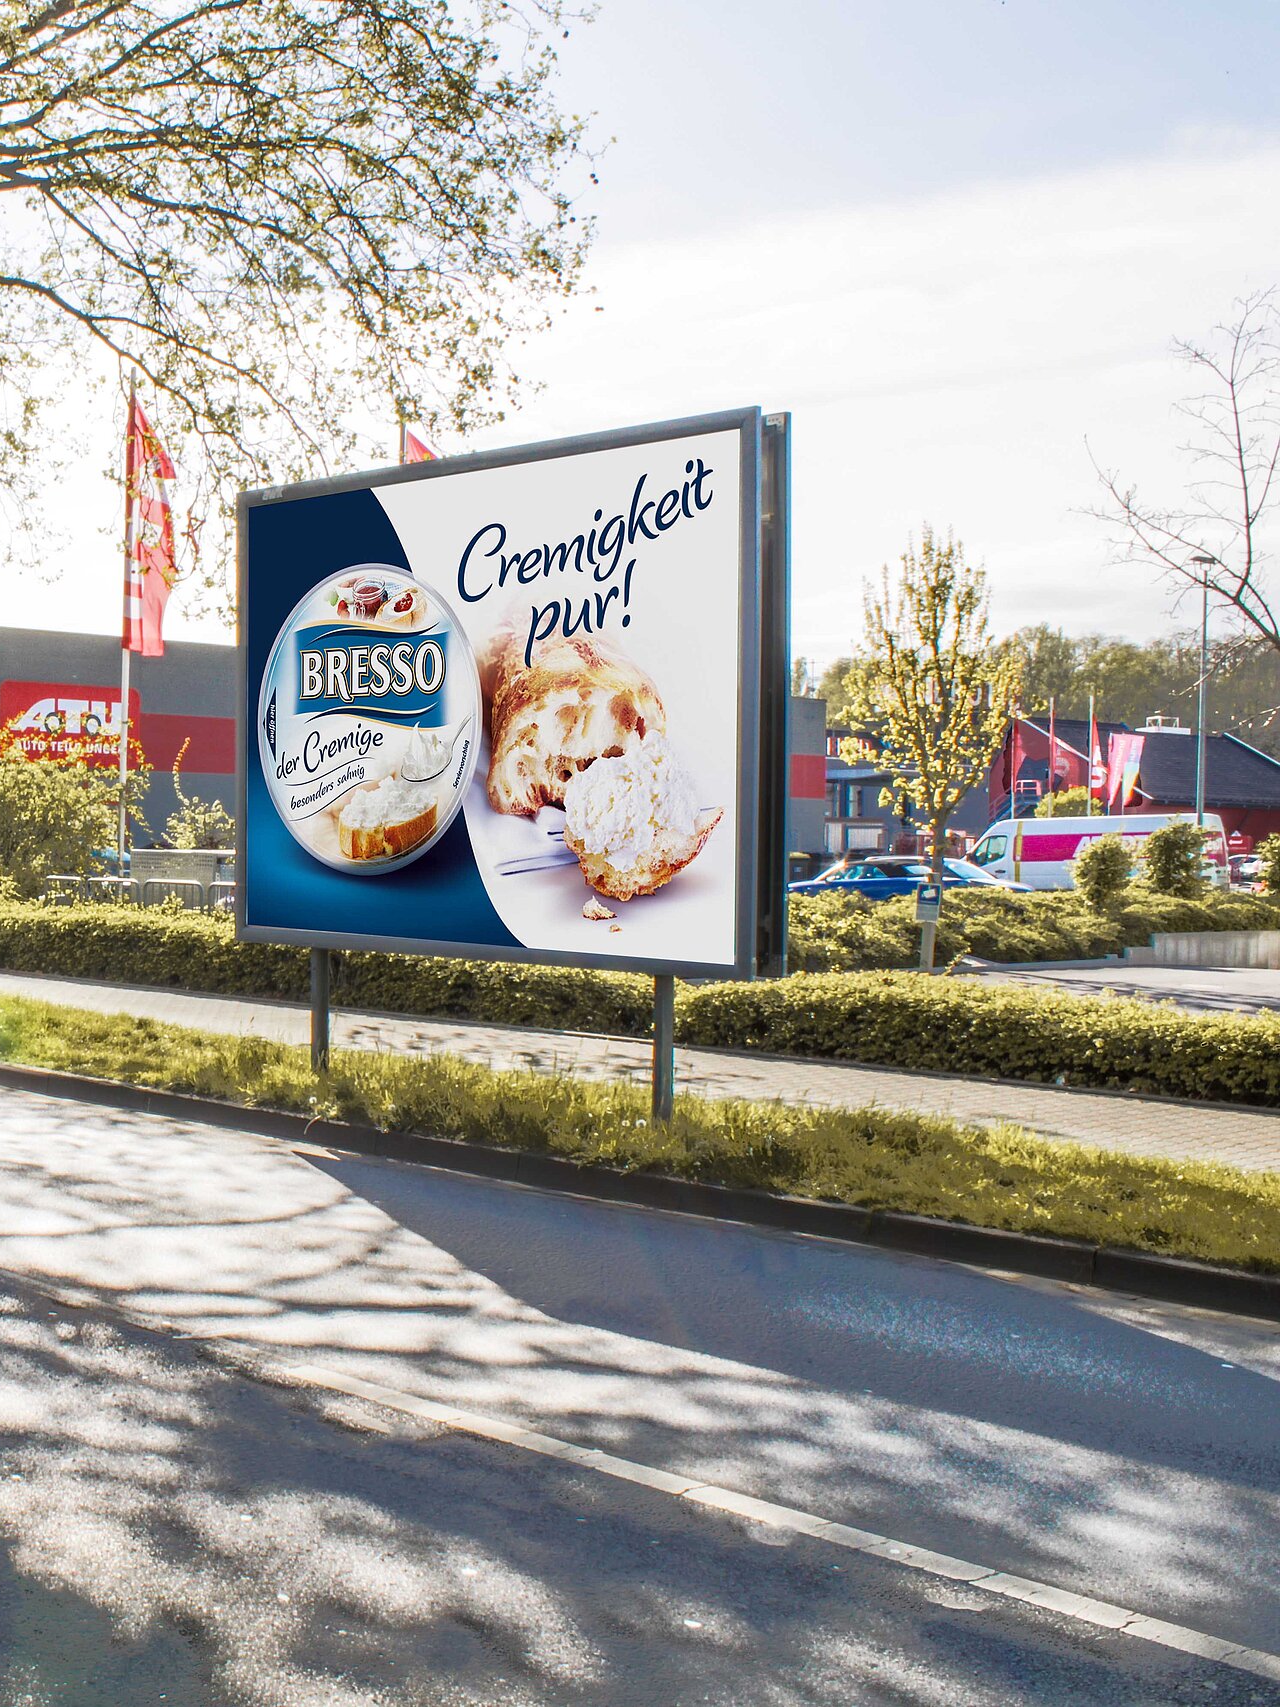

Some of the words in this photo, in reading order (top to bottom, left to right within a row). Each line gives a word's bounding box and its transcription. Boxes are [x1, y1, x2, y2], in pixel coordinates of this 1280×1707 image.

[457, 458, 714, 603] Cremigkeit
[524, 558, 637, 669] pur!
[300, 640, 447, 703] BRESSO
[10, 698, 123, 737] ATU
[268, 720, 276, 744] öffnen
[276, 751, 300, 780] der
[303, 723, 384, 774] Cremige
[452, 739, 470, 789] Serviervorschlag
[290, 782, 334, 811] besonders
[336, 764, 366, 790] sahnig
